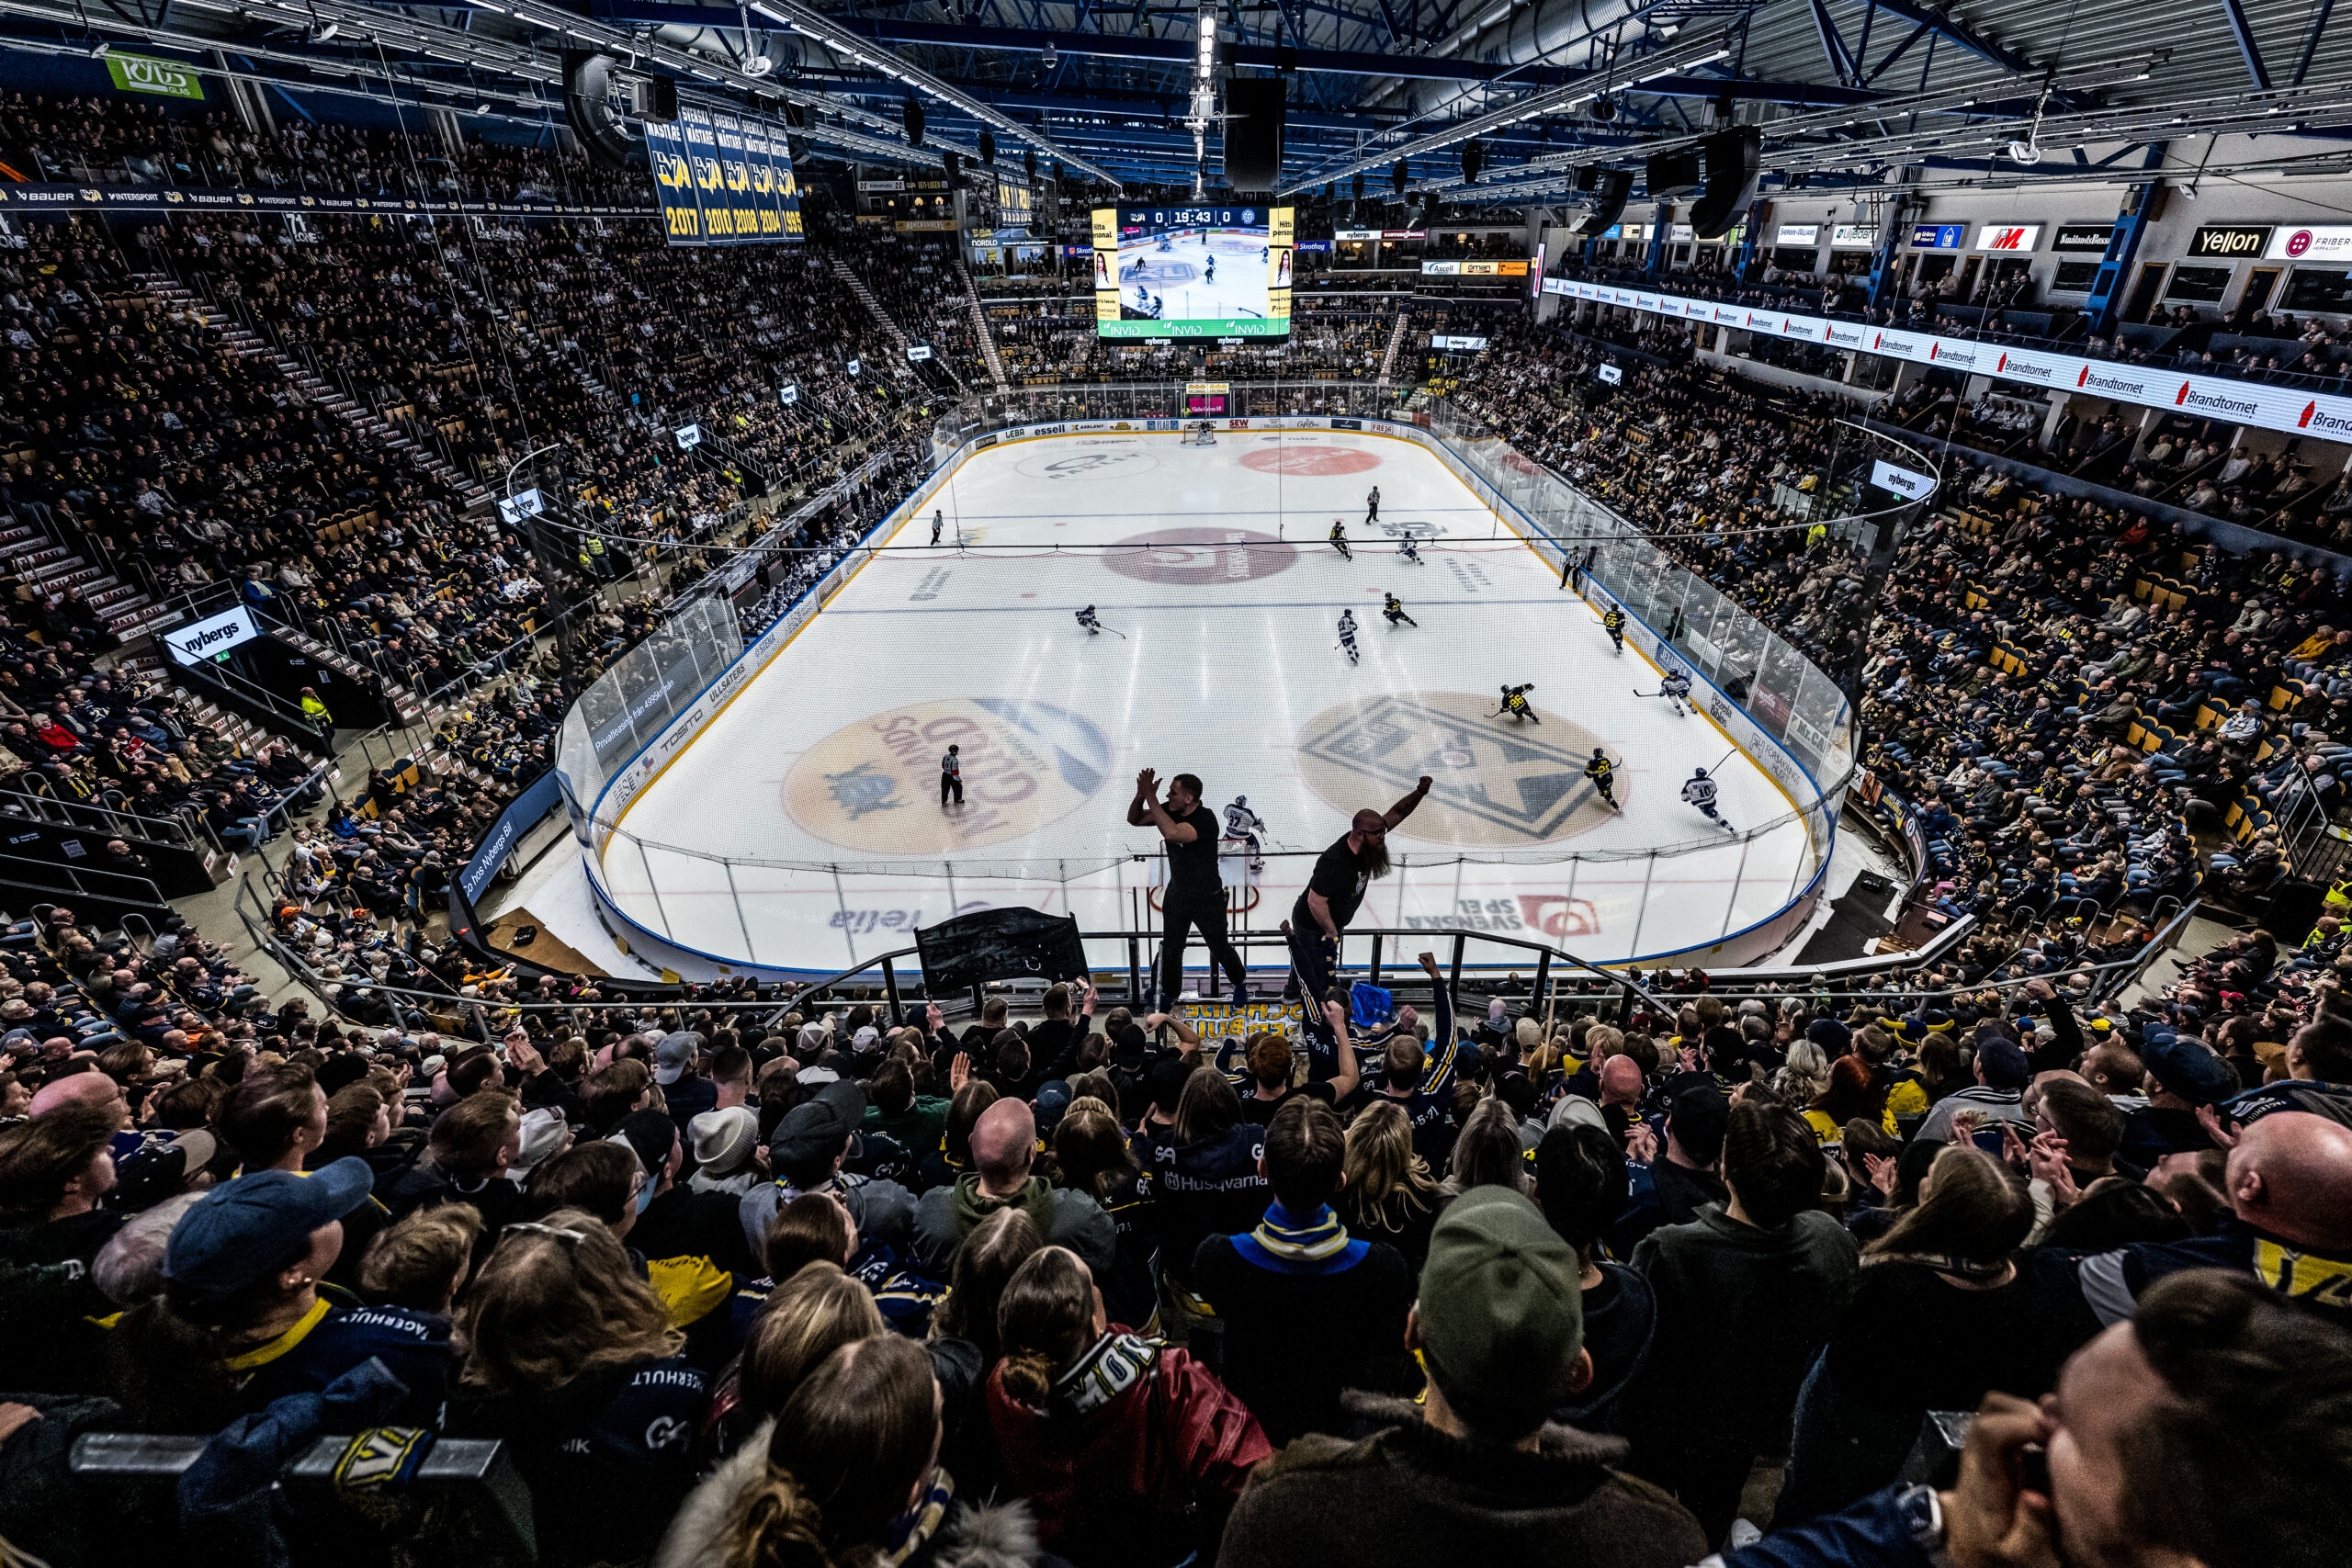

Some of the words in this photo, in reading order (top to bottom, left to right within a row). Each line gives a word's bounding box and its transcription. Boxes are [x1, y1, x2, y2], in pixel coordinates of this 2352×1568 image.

[682, 107, 711, 126] SVENSKA
[714, 112, 741, 131] SVENSKA
[686, 125, 715, 145] MÄSTARE
[742, 119, 765, 136] SVENSKA
[767, 126, 787, 141] SVENSKA
[718, 130, 743, 149] MÄSTARE
[745, 135, 769, 153] MÄSTARE
[29, 193, 74, 201] BAUER
[114, 193, 158, 201] INTERSPORT
[666, 207, 699, 235] 2017
[705, 208, 733, 234] 2010
[734, 209, 759, 233] 2008
[760, 209, 781, 233] 2004
[782, 210, 803, 233] 1995
[1155, 212, 1163, 223] 0
[1175, 211, 1211, 223] 19:43
[1223, 211, 1231, 222] 0
[972, 239, 998, 247] NORDLO
[2200, 231, 2260, 254] Yellon
[1111, 325, 1140, 335] INVID
[1172, 325, 1202, 335] INVID
[1235, 324, 1264, 334] INVID
[1145, 337, 1171, 345] nybergs
[1217, 336, 1244, 344] nybergs
[1751, 317, 1772, 328] Brandtornet
[1788, 323, 1813, 335] Brandtornet
[1830, 331, 1860, 344] Brandtornet
[1880, 339, 1914, 353] Brandtornet
[1937, 349, 1976, 365] Brandtornet
[2005, 360, 2052, 378] Brandtornet
[2087, 374, 2144, 394] Brandtornet
[2188, 390, 2258, 414] Brandtornet
[1035, 424, 1066, 436] essell
[1373, 424, 1392, 434] FREJA
[1888, 473, 1916, 491] nybergs
[32, 549, 60, 564] MAXI
[102, 587, 128, 602] MAXI
[109, 615, 135, 629] MAXI
[1605, 616, 1618, 627] 55
[185, 622, 240, 652] nybergs
[1510, 694, 1524, 708] 96
[1712, 692, 1733, 718] Pizzeria
[595, 715, 635, 752] Privatleasing
[633, 705, 645, 719] från
[661, 708, 703, 751] TOSITO
[1699, 784, 1711, 797] 10
[1228, 815, 1243, 828] 37
[471, 867, 485, 887] hos
[481, 836, 505, 870] Nybergs
[503, 821, 513, 838] Bil
[1459, 898, 1518, 915] SPEL
[830, 909, 922, 934] Telia
[1405, 915, 1524, 931] SVENSKA
[1182, 1174, 1269, 1192] Husqvarna
[337, 1311, 430, 1341] FAGERHULT
